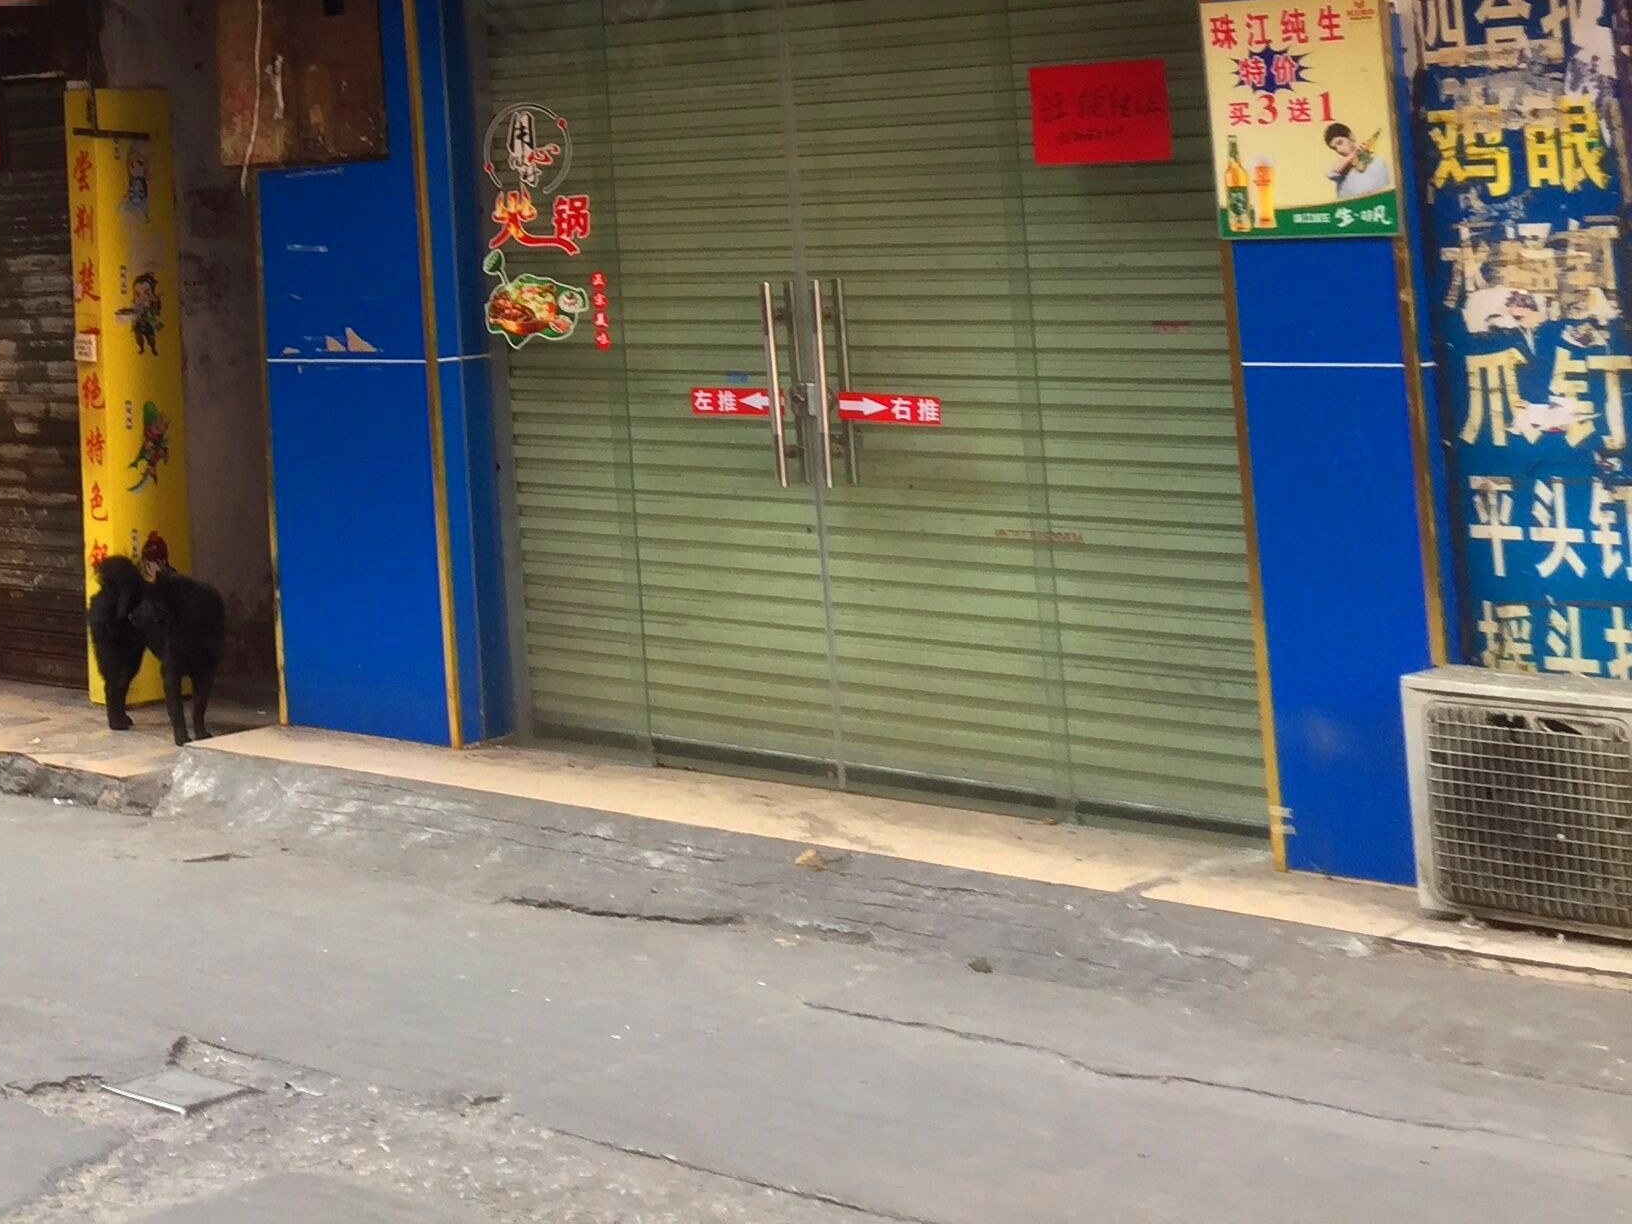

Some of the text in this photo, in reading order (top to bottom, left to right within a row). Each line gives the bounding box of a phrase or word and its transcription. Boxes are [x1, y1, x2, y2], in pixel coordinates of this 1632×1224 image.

[1210, 5, 1345, 49] 珠江纯生
[1239, 55, 1300, 86] 特价
[1229, 91, 1336, 127] 买3送1
[489, 183, 591, 255] 火锅
[693, 389, 738, 413] 左推
[891, 396, 940, 423] 右推
